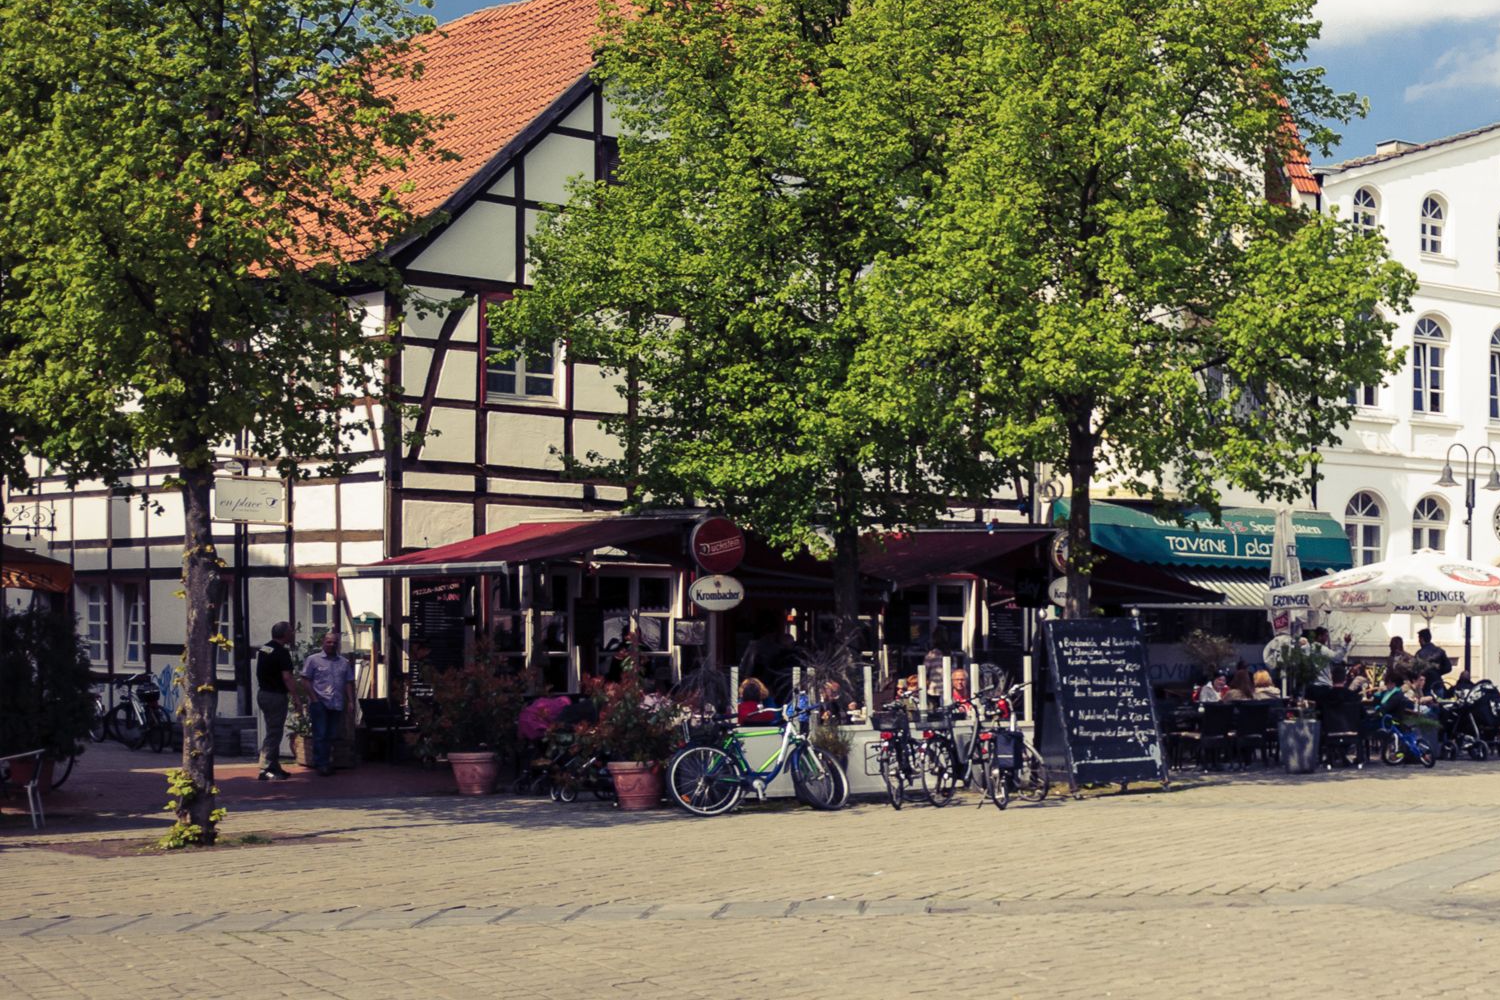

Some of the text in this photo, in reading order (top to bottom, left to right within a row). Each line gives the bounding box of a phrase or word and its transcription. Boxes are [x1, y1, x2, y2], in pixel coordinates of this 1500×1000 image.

[696, 589, 740, 601] Krombacher
[1273, 594, 1310, 606] ERDINGER
[1417, 590, 1466, 603] ERDINGER
